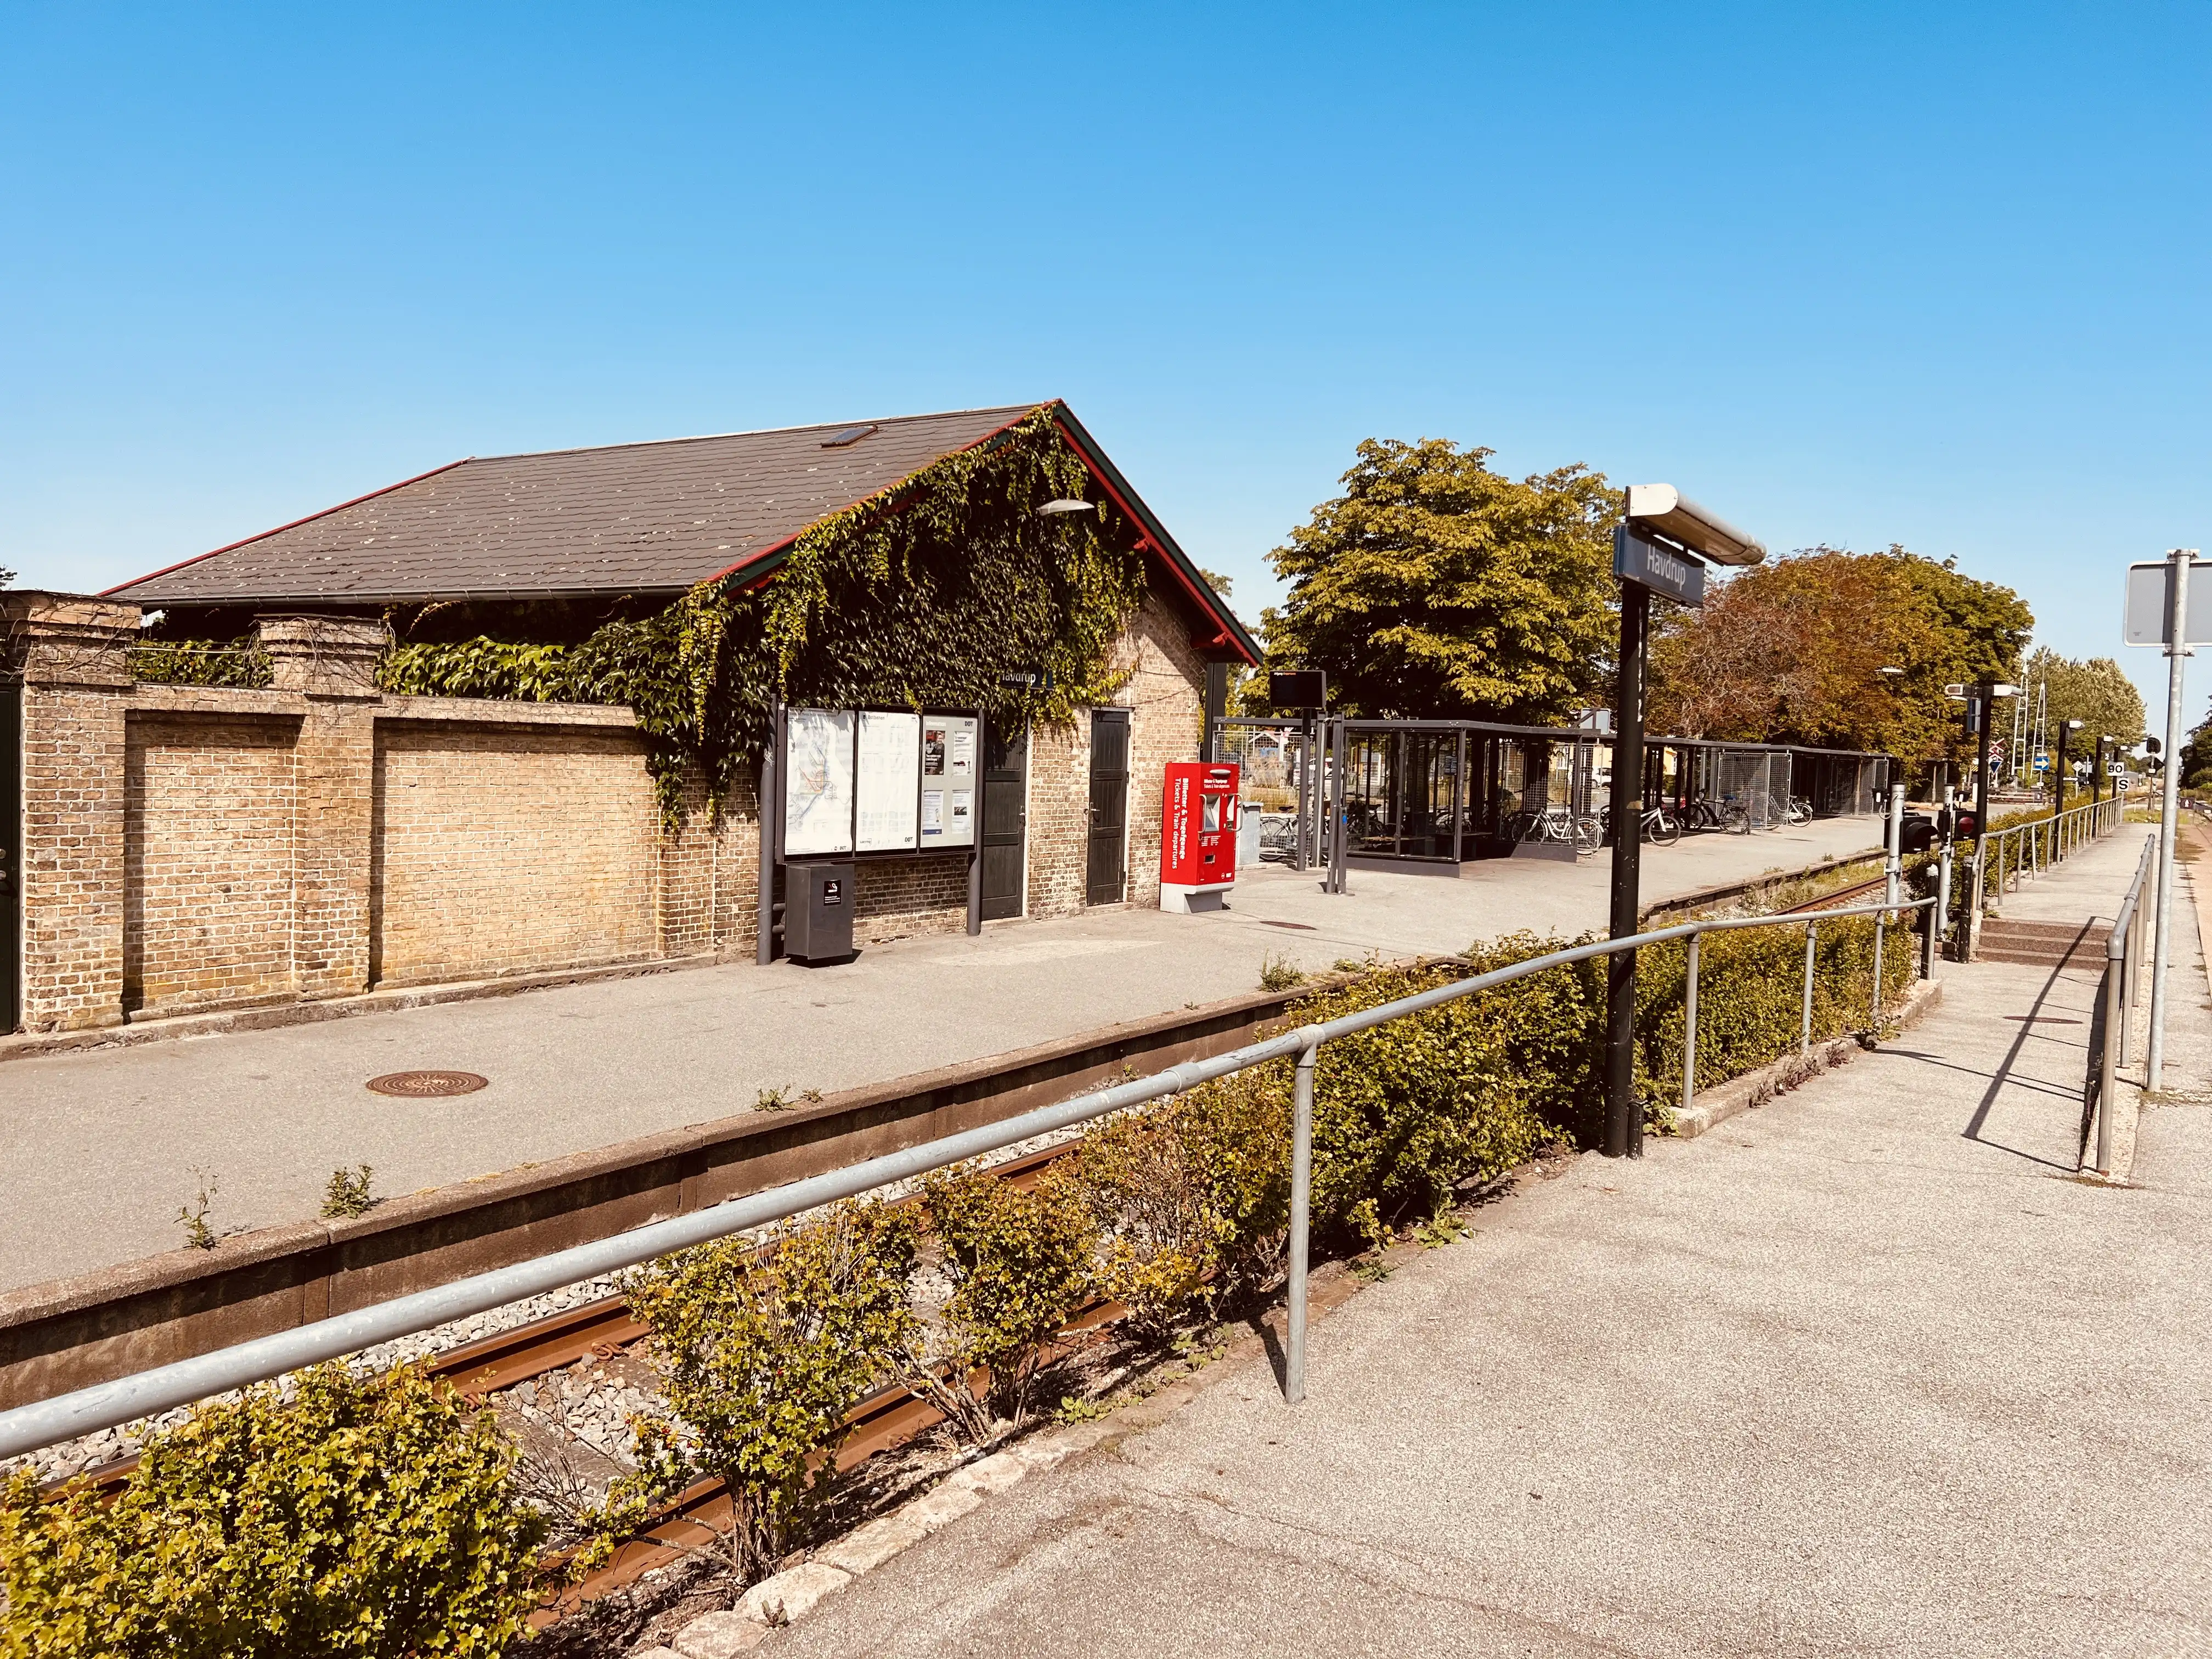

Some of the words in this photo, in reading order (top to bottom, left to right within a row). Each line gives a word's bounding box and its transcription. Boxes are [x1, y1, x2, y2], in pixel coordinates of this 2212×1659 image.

[1647, 544, 1686, 591] Havdrup
[2108, 765, 2123, 773] 90
[2119, 780, 2129, 790] S
